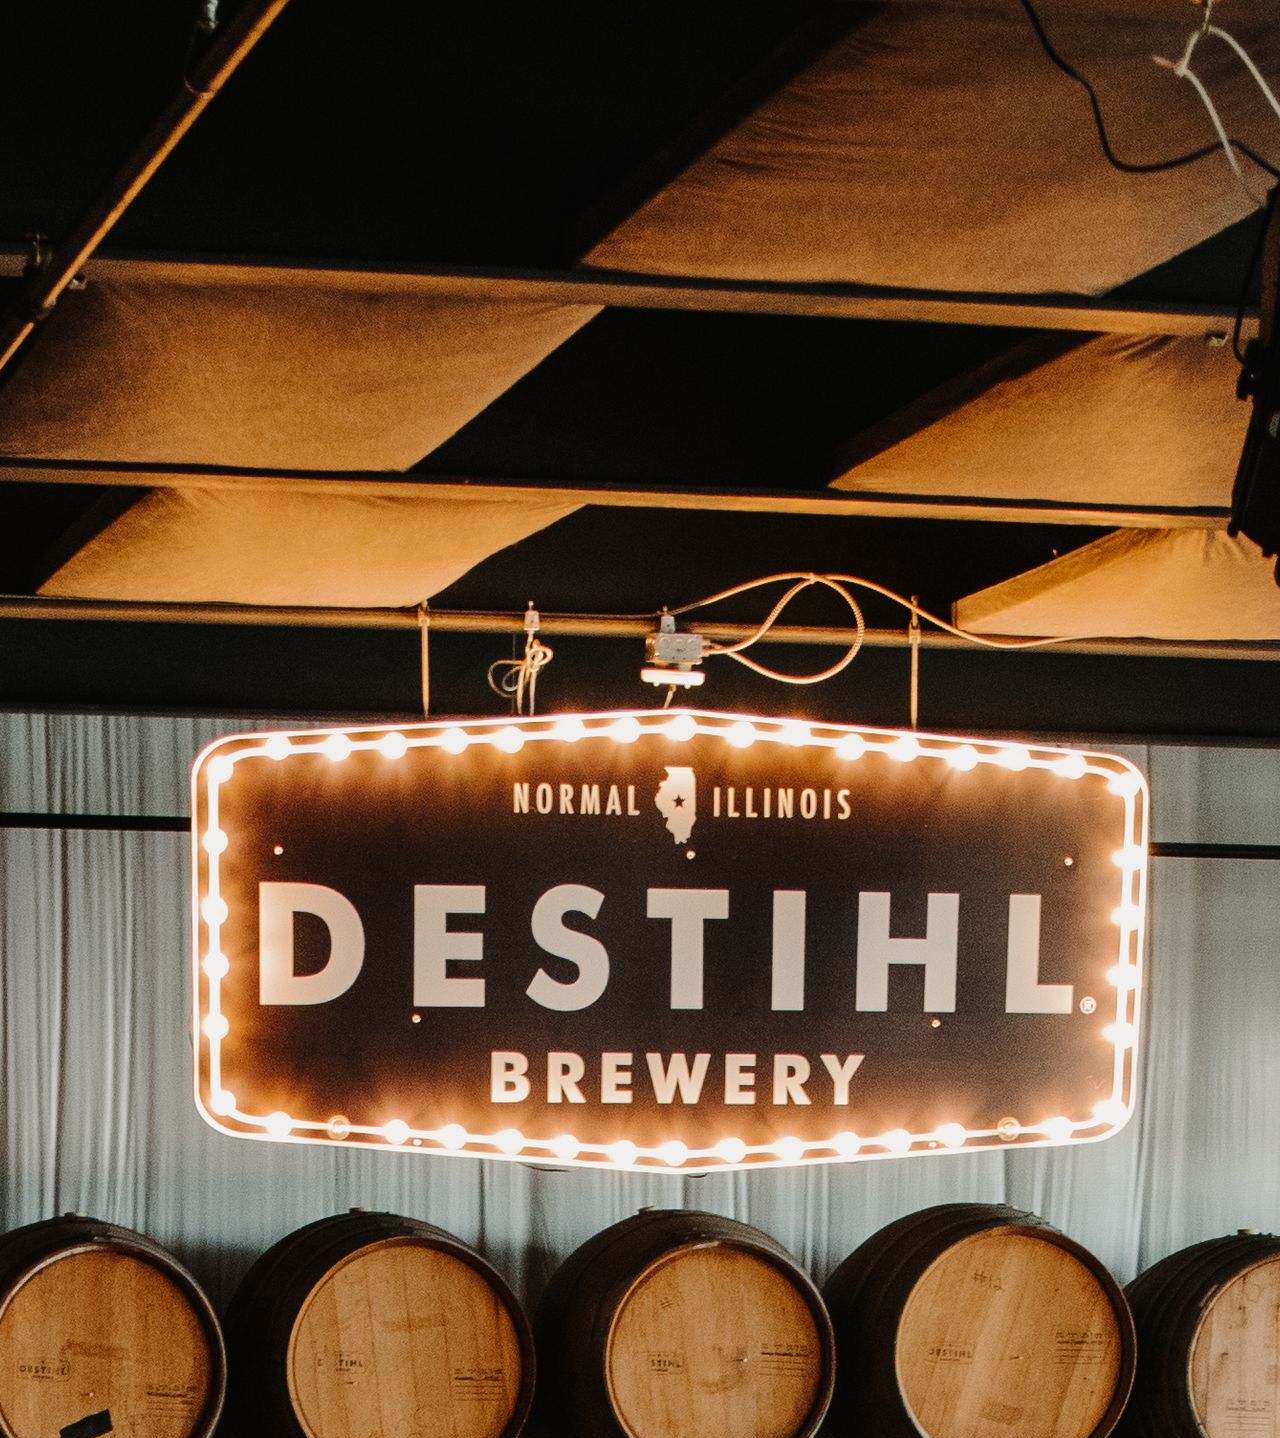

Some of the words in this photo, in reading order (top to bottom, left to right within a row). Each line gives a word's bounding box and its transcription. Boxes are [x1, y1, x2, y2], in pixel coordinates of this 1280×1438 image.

[513, 781, 641, 816] NORMAL
[712, 785, 852, 820] ILLINOIS
[490, 1050, 865, 1106] BREWERY
